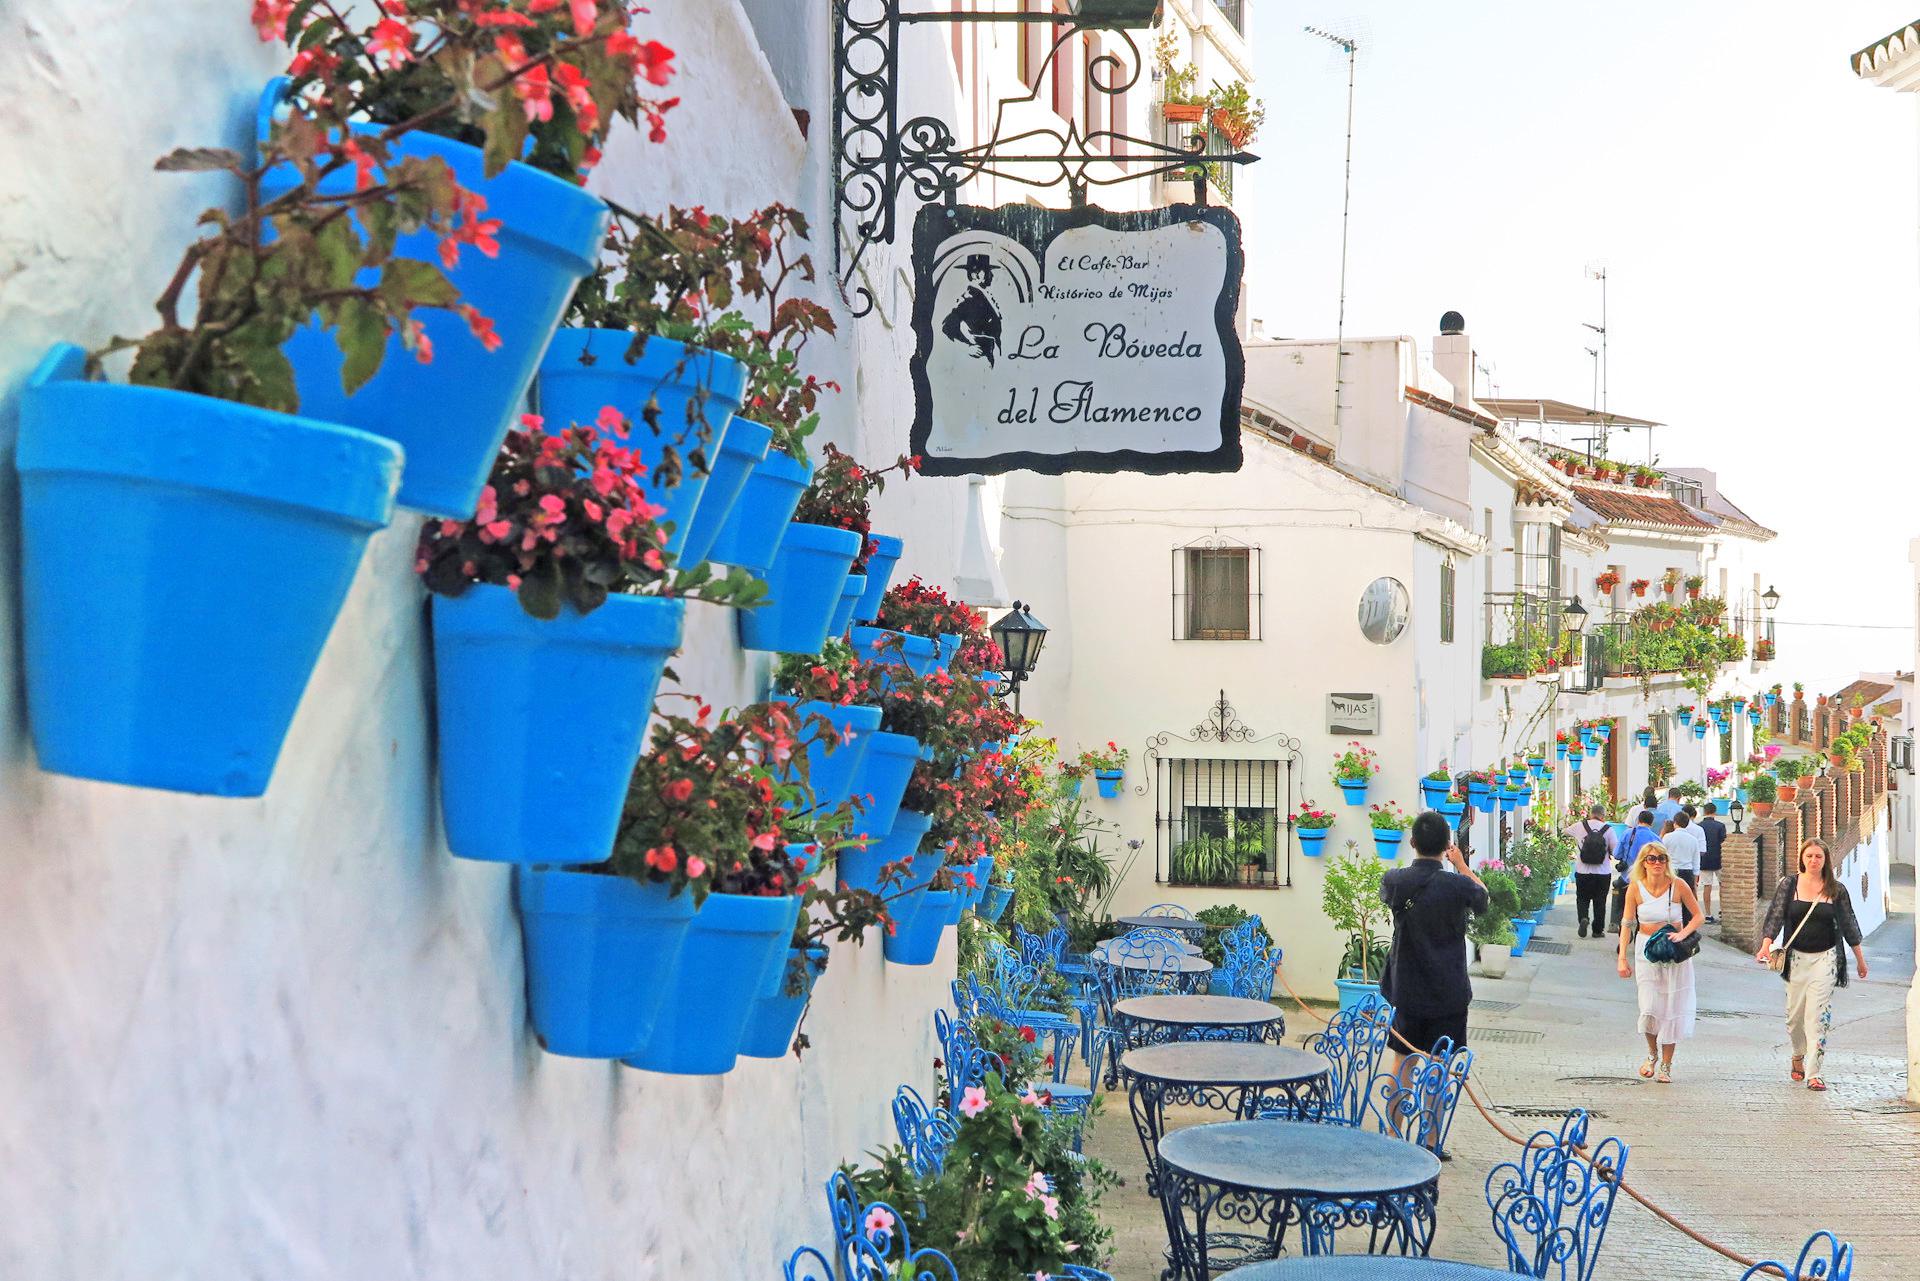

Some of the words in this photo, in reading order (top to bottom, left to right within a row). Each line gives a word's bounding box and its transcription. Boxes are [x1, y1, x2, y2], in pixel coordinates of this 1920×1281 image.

[1057, 256, 1075, 271] El
[1078, 254, 1148, 273] Café-Bar
[1038, 284, 1103, 300] Histórico
[1108, 286, 1123, 298] de
[1127, 282, 1173, 302] Mijas
[1008, 325, 1060, 360] La
[1084, 322, 1203, 359] Bóveda
[997, 387, 1039, 424] del
[1048, 380, 1202, 424] Flamenco
